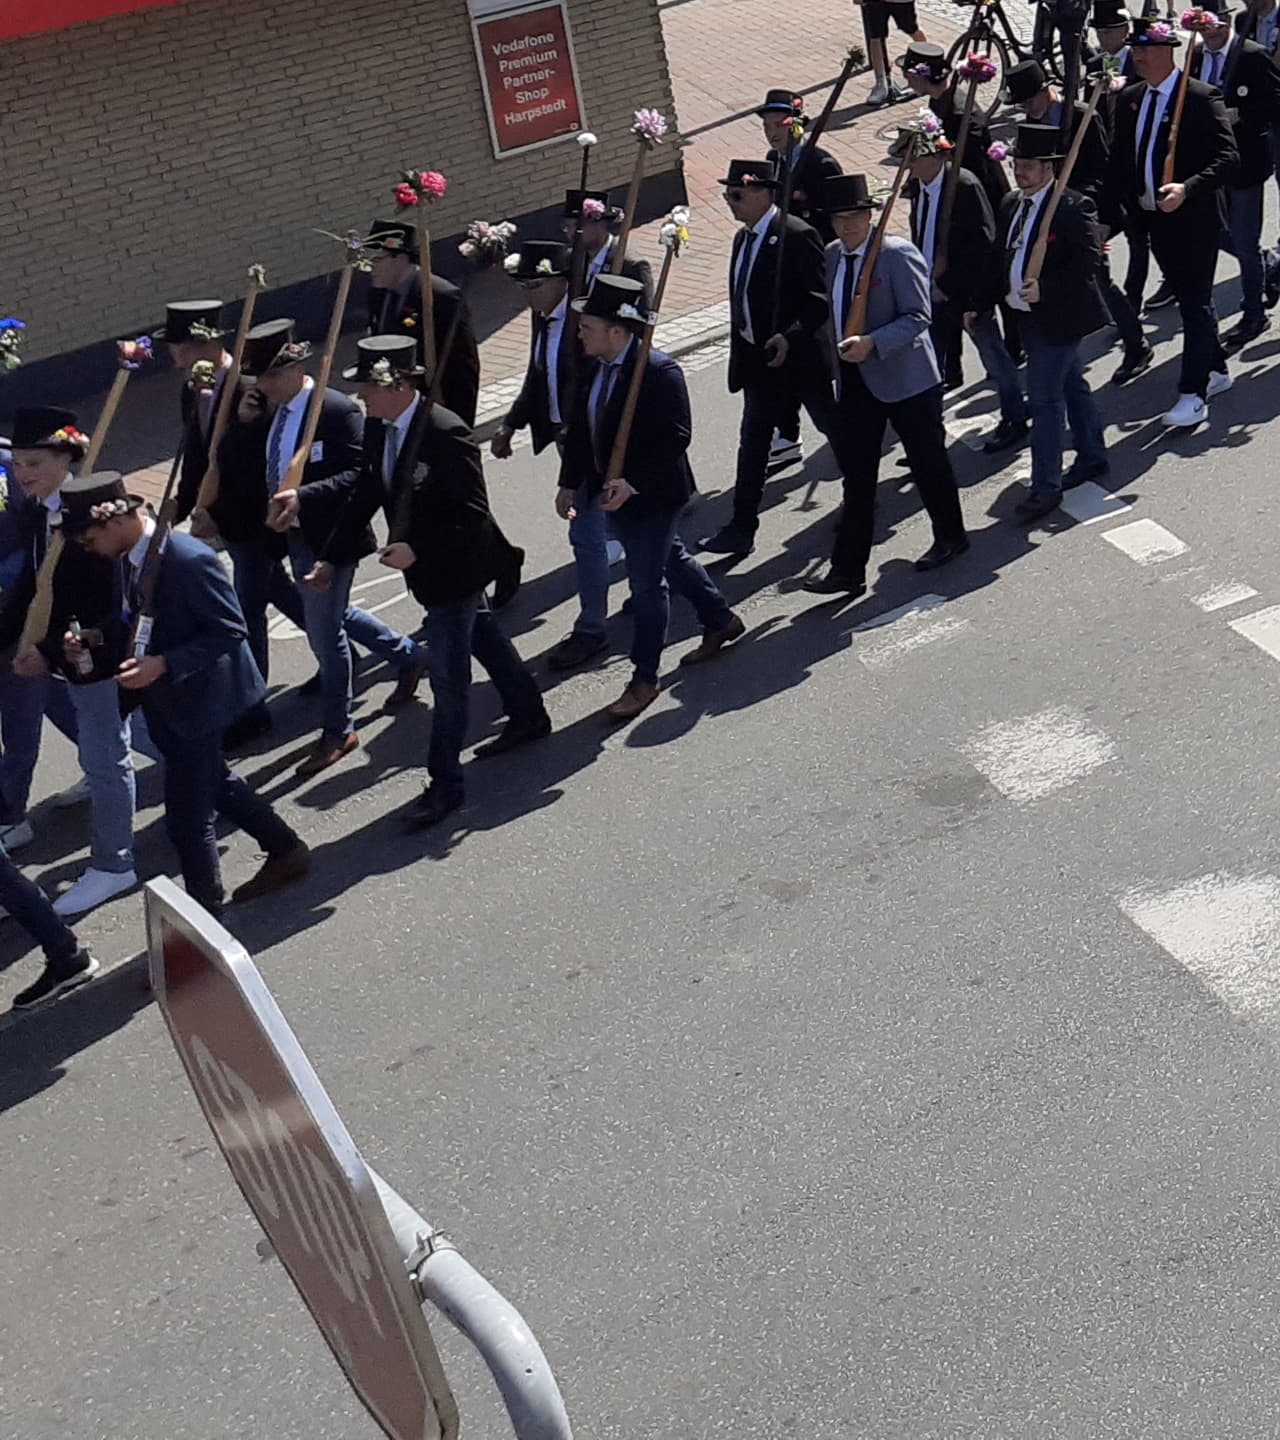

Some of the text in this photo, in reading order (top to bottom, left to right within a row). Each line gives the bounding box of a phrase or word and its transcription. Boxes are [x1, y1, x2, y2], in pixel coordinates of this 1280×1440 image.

[492, 32, 555, 56] Vodafone
[500, 49, 558, 72] Premium
[503, 68, 556, 89] Partner-
[515, 87, 550, 104] Shop
[504, 99, 567, 125] Harpstedt
